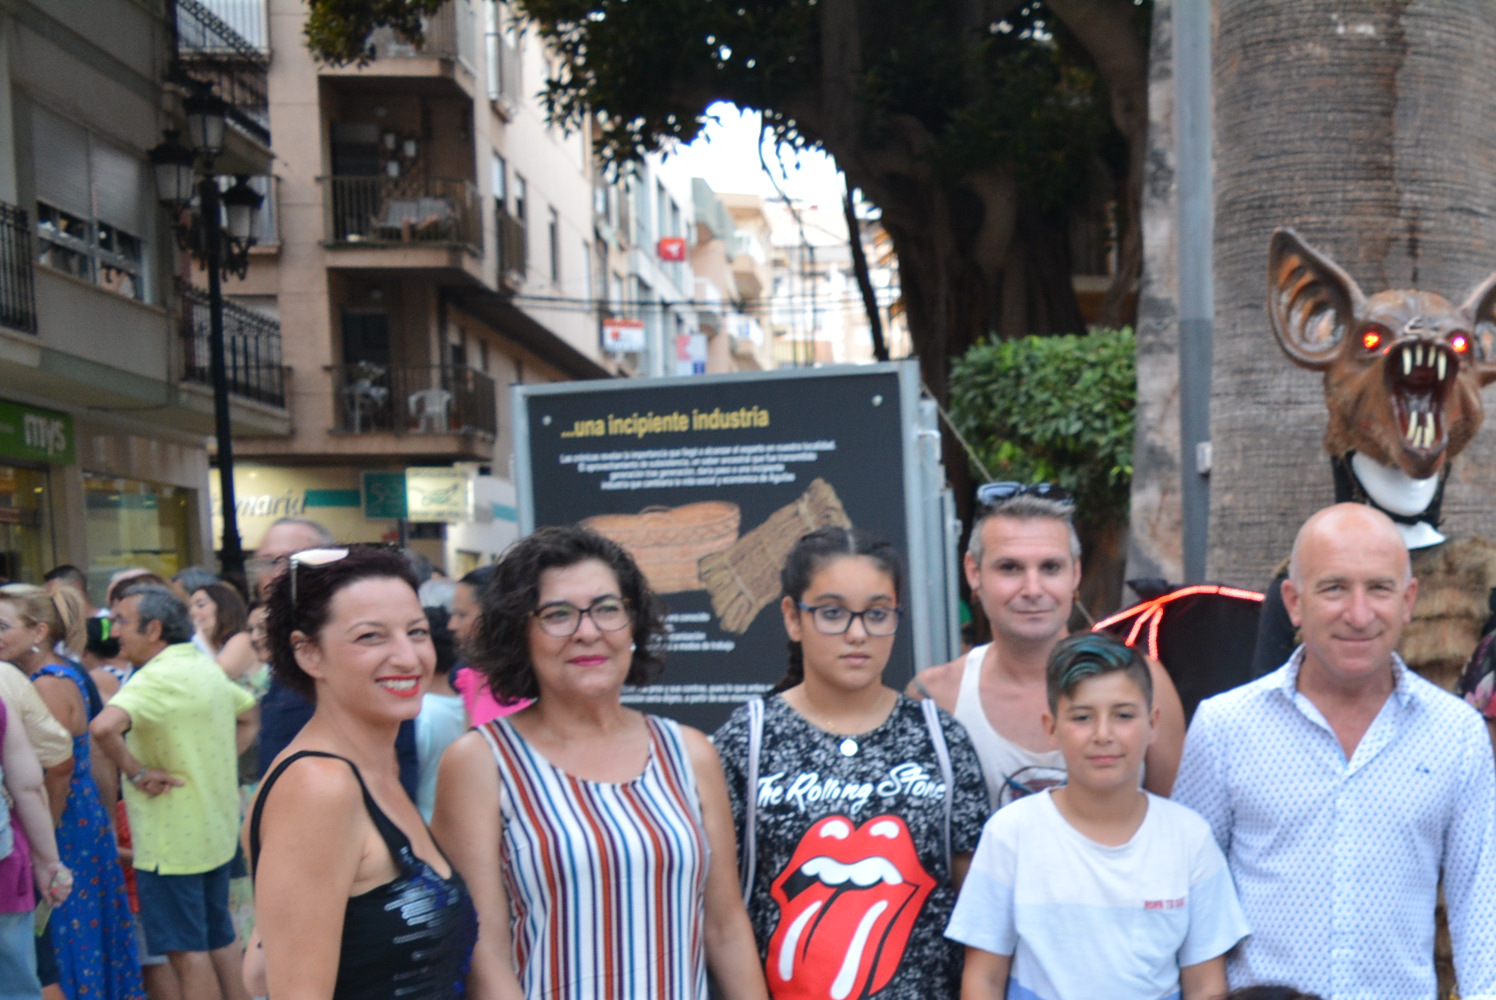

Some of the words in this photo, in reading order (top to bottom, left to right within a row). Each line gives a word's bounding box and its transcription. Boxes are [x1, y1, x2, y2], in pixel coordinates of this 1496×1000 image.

[608, 411, 690, 439] incipiente
[692, 405, 770, 430] industria
[757, 770, 786, 808] The
[785, 770, 874, 814] Rolling
